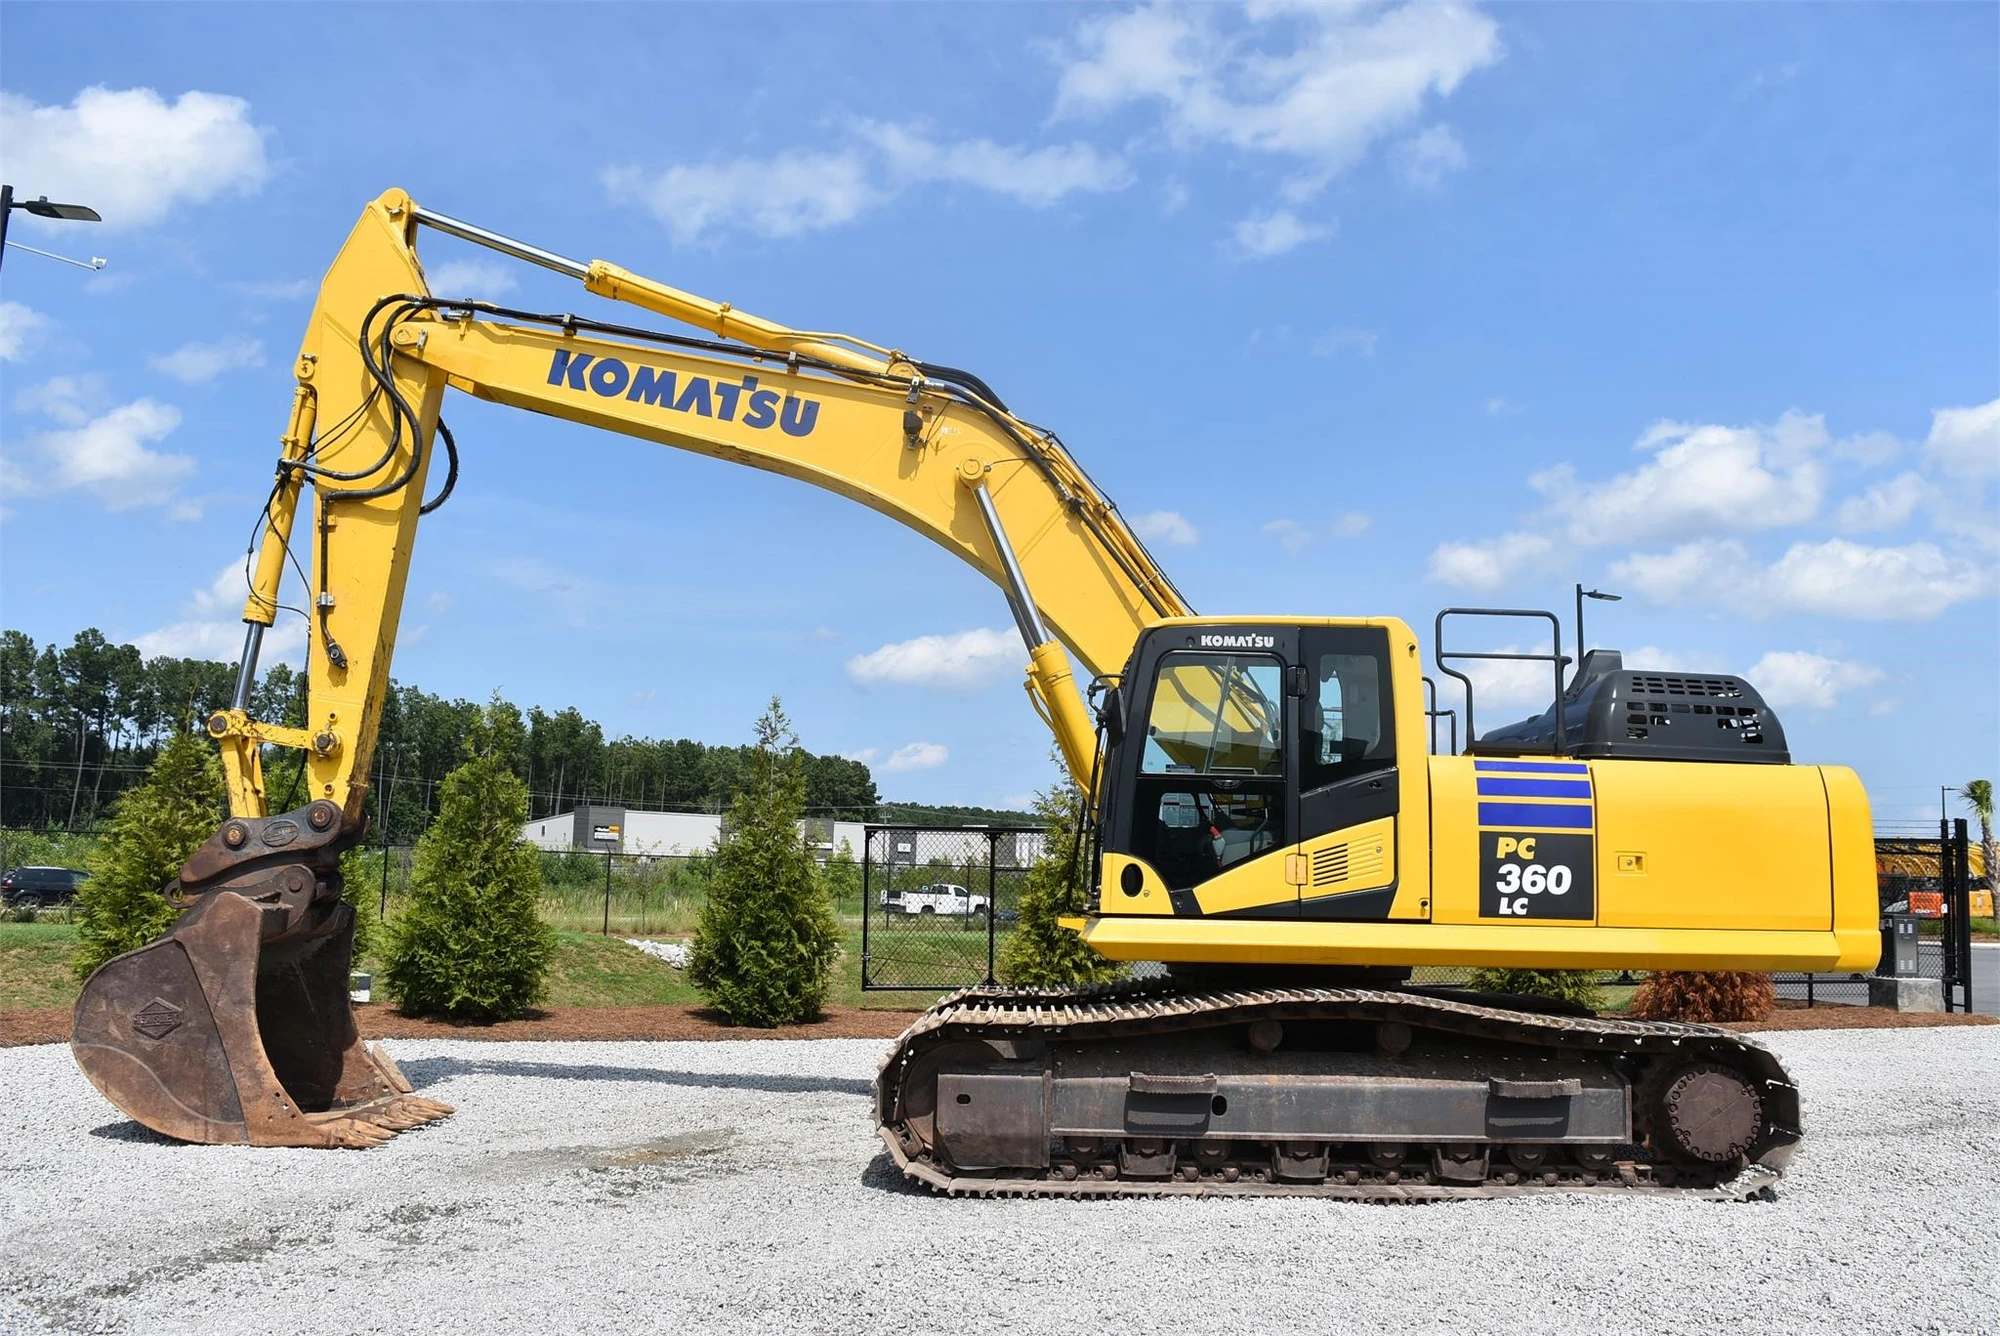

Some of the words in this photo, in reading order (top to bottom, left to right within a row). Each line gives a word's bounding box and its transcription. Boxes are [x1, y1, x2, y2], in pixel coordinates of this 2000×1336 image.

[547, 348, 820, 437] KOMATSU
[1200, 633, 1274, 648] KOMATSU
[1496, 837, 1536, 860] PC
[1496, 863, 1572, 895] 360
[1499, 897, 1529, 915] LC
